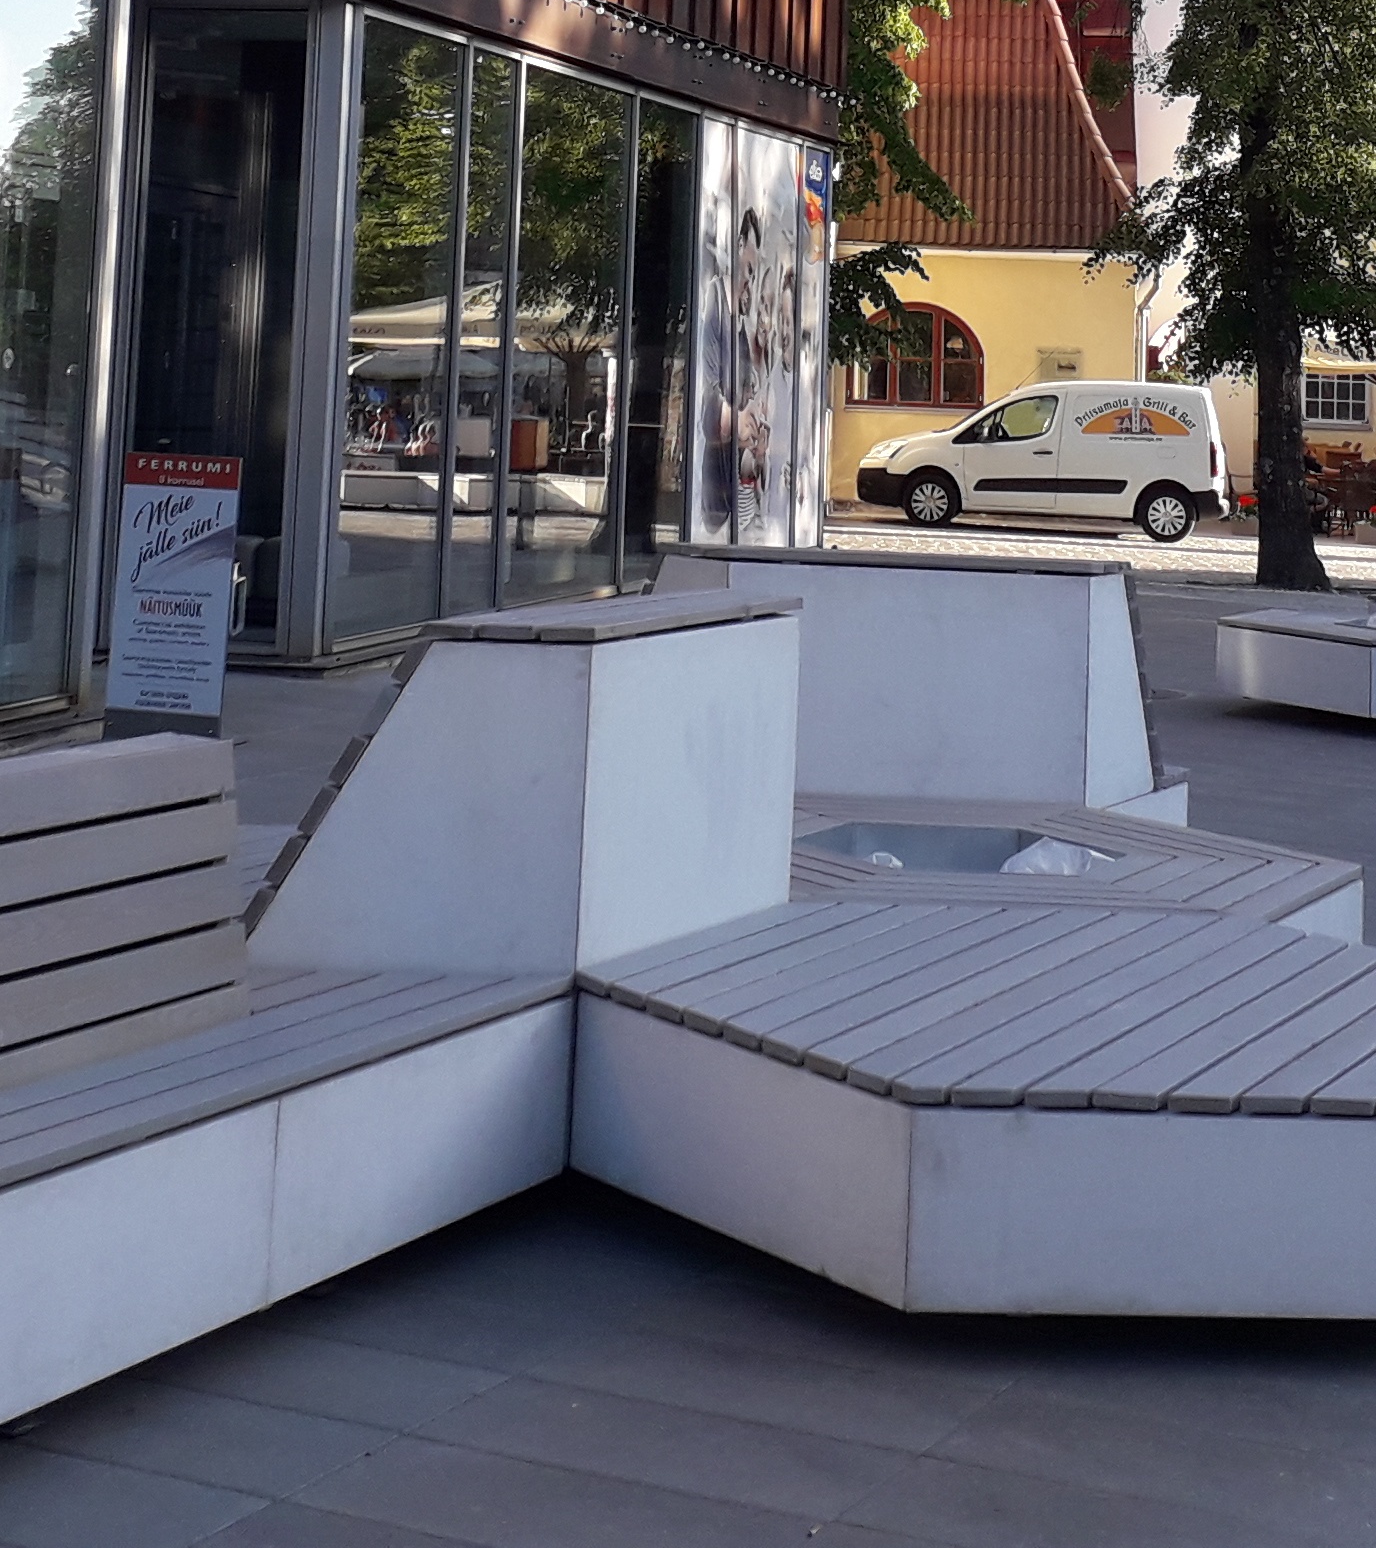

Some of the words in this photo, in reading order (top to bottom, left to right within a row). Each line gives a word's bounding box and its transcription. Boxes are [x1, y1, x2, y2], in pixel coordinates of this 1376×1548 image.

[1178, 412, 1197, 430] Bar
[137, 458, 231, 474] FERRUMI
[133, 494, 195, 533] Meie
[131, 528, 177, 583] jälle
[182, 501, 223, 545] siin!
